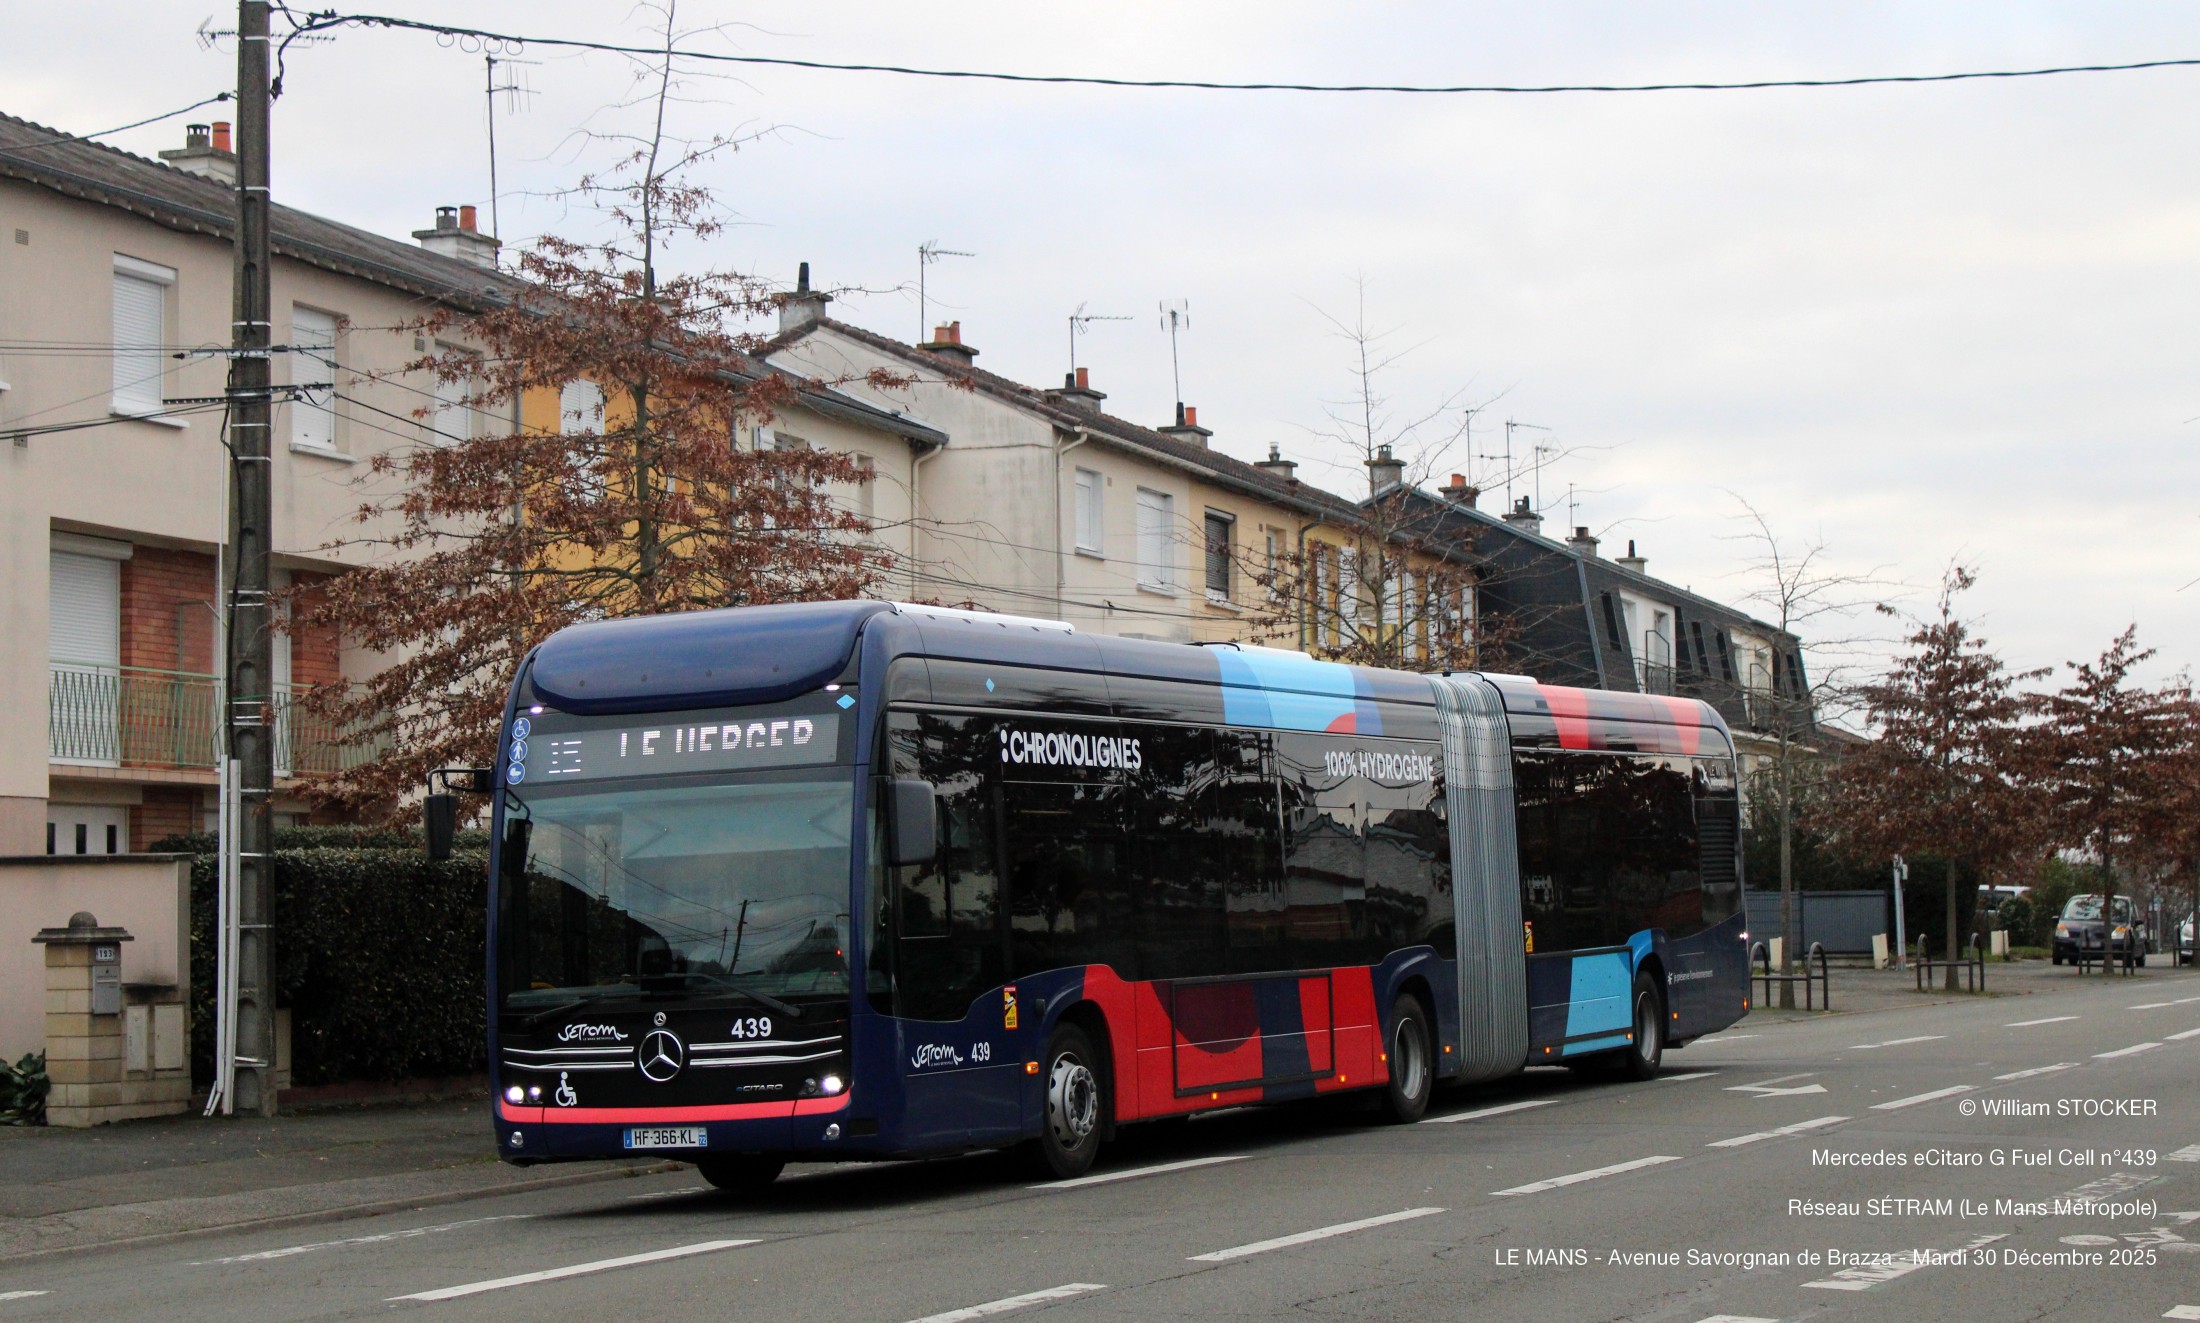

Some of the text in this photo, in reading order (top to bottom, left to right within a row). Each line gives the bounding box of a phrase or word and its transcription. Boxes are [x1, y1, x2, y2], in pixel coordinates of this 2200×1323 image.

[1324, 749, 1435, 782] 100% HYDROGÈNE
[731, 1017, 772, 1039] 439
[971, 1041, 991, 1062] 439
[634, 1129, 696, 1145] HF-366-KL
[698, 1136, 706, 1144] 72
